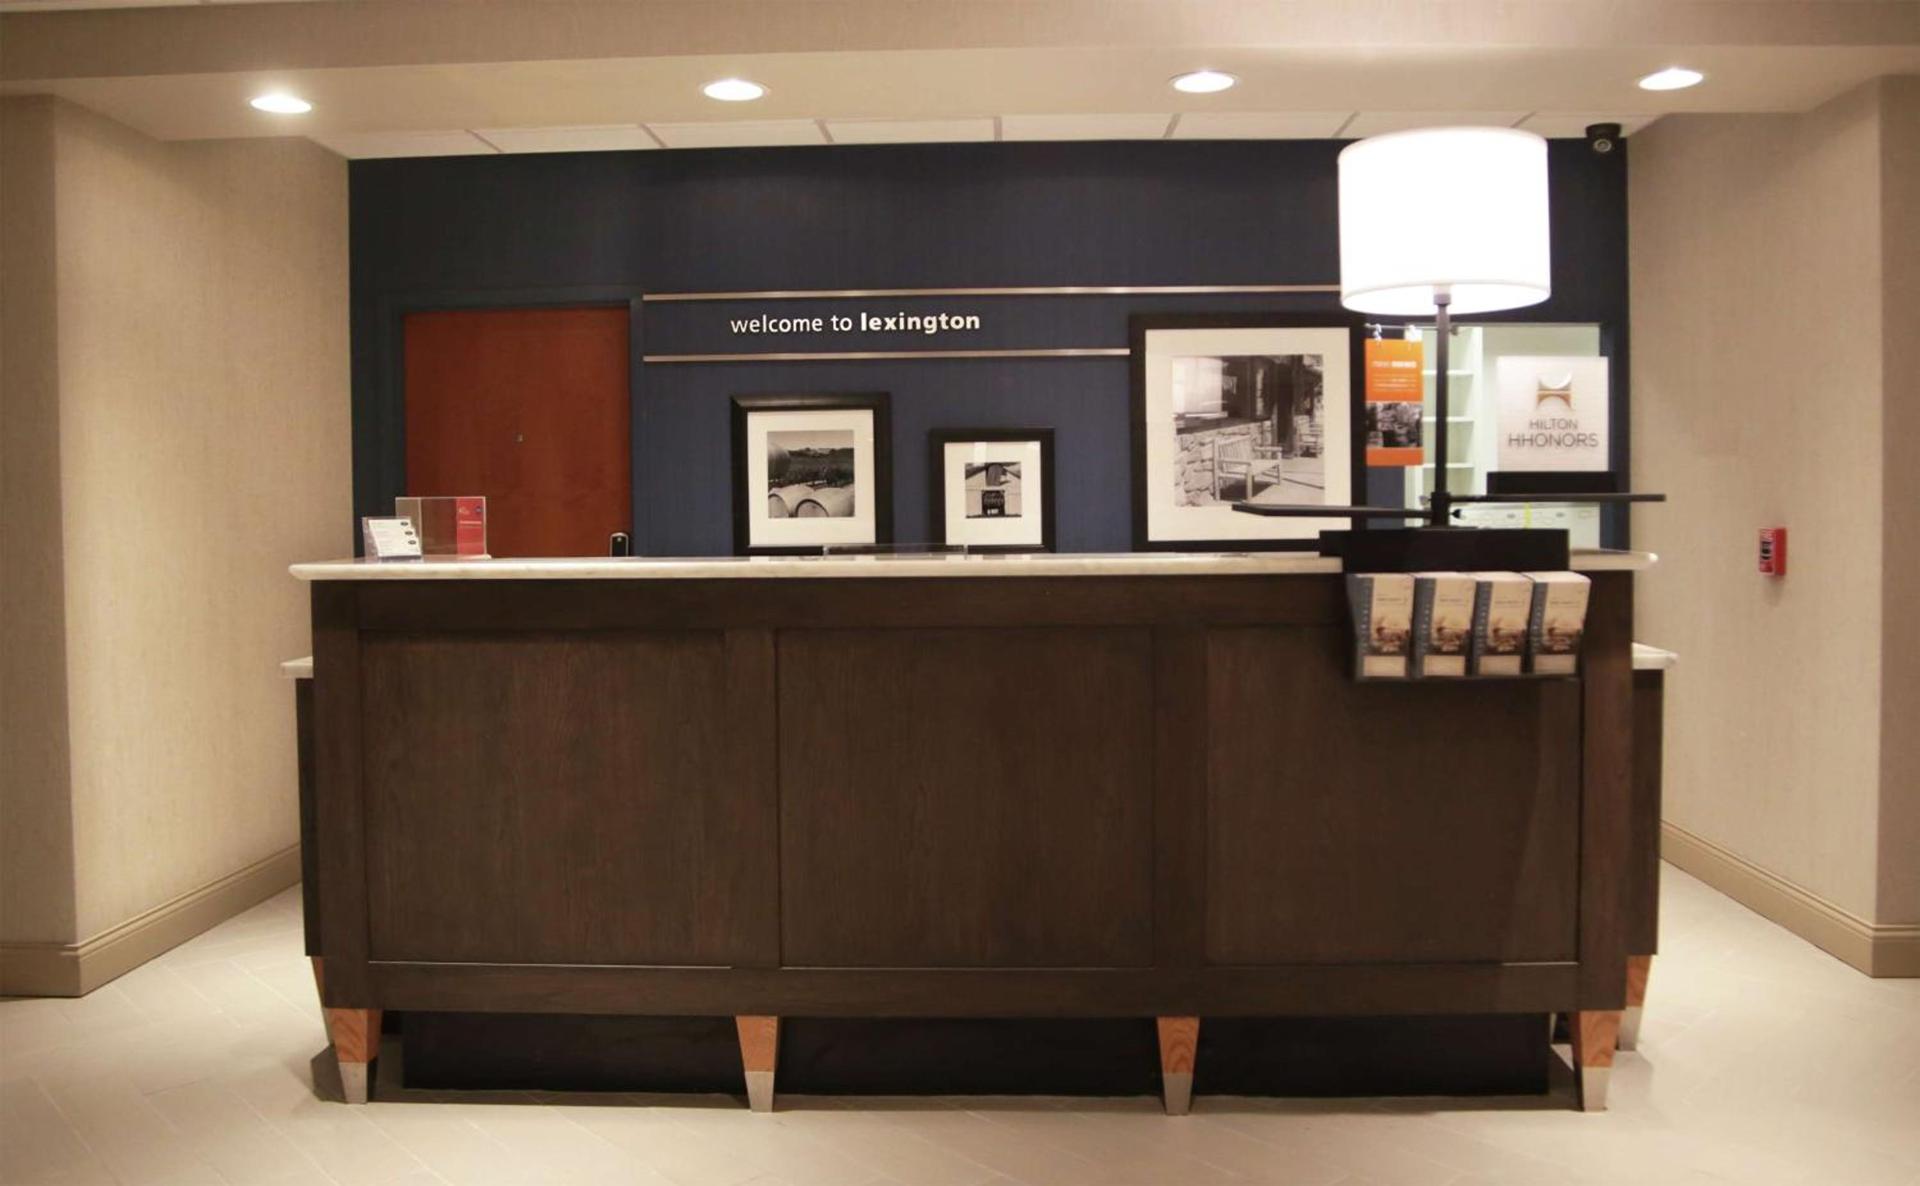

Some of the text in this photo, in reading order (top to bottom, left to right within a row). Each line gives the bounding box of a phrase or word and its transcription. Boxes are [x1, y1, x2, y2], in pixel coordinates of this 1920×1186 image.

[730, 312, 981, 334] welcome to lexington
[1529, 418, 1578, 430] HILTON
[1508, 432, 1599, 447] HHONORS
